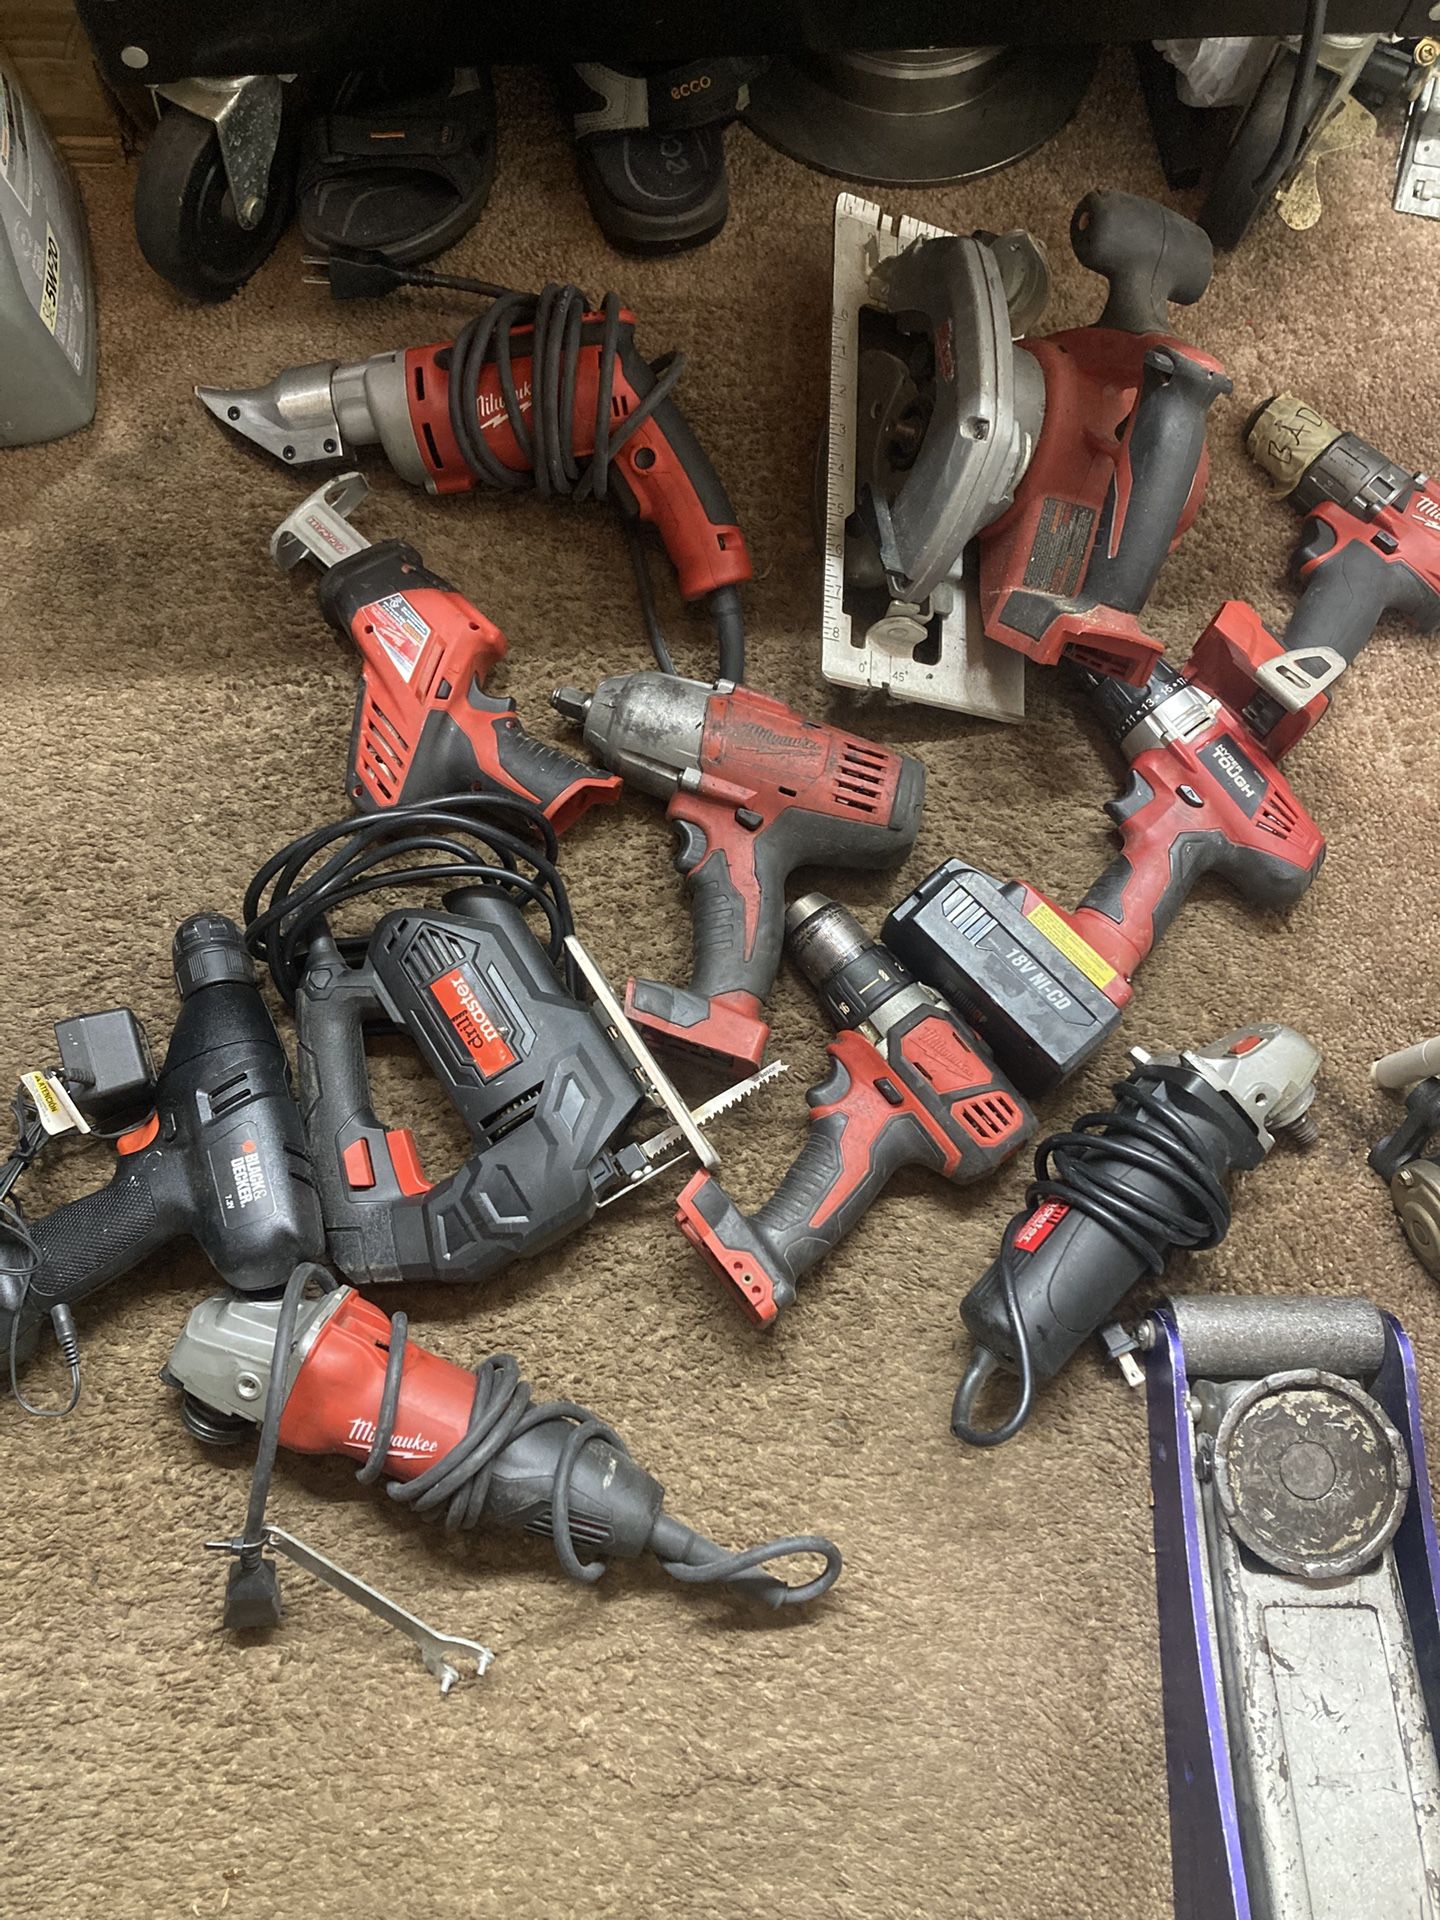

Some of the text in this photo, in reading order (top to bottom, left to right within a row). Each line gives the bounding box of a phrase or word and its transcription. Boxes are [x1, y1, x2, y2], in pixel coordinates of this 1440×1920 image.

[671, 75, 711, 100] ecco
[1268, 406, 1323, 464] BAD
[837, 502, 845, 514] 5
[835, 585, 842, 597] 7
[832, 626, 840, 639] 8
[1211, 749, 1256, 799] TOUGH
[1215, 743, 1244, 774] HYPER
[1005, 947, 1072, 1010] 18V NI-CD
[450, 976, 499, 1043] master
[451, 1009, 484, 1049] drill
[39, 1082, 58, 1112] ATENCIÓN
[348, 1417, 438, 1452] Miaukee
